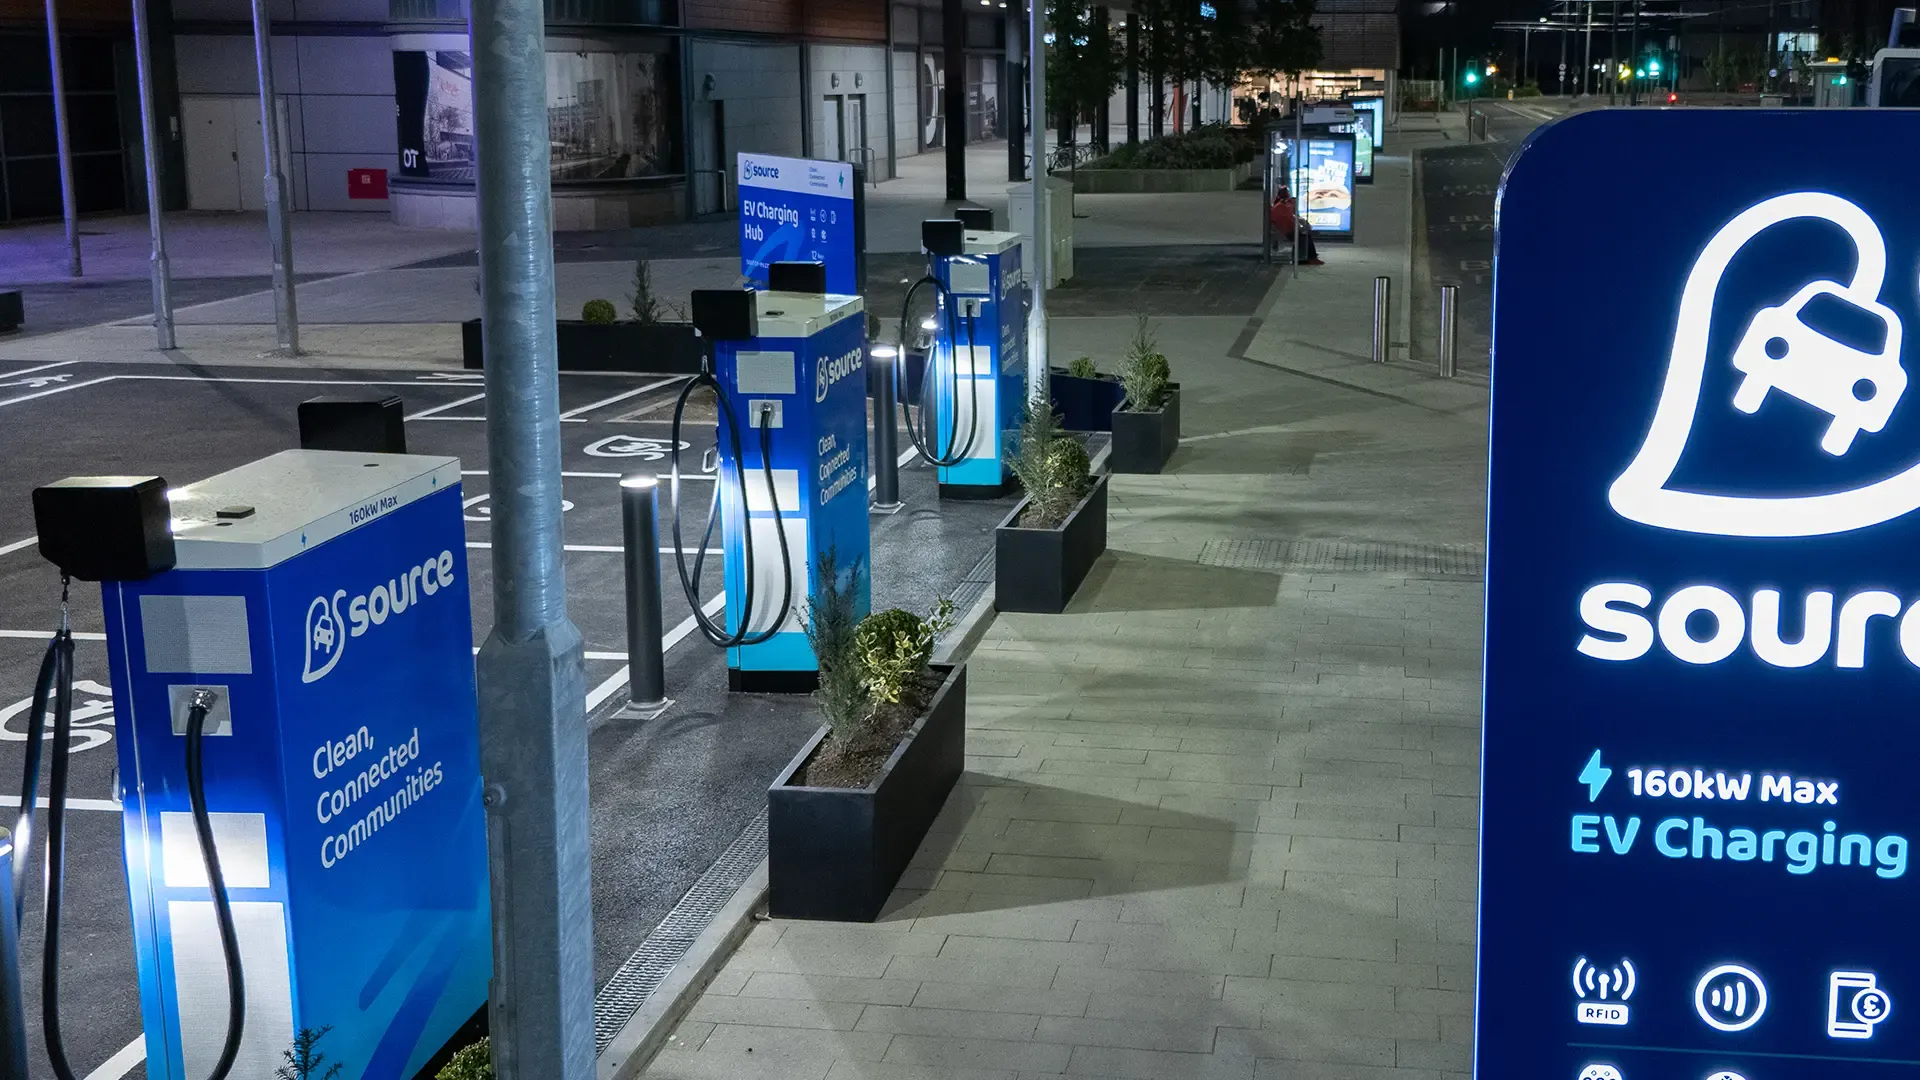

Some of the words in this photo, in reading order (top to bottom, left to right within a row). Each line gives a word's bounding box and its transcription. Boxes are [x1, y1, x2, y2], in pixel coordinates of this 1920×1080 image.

[753, 165, 780, 179] source
[744, 200, 756, 216] EV
[757, 201, 799, 228] Charging
[745, 223, 764, 242] Hub
[828, 347, 863, 386] source
[818, 433, 837, 457] Clean,
[819, 442, 850, 481] Connected
[349, 501, 378, 525] 160kW
[380, 495, 398, 512] Max
[349, 550, 454, 638] source
[313, 725, 374, 780] Clean,
[316, 727, 420, 824] Connected
[1627, 768, 1752, 801] 160kW
[1760, 774, 1839, 805] Max
[320, 760, 444, 869] Communities
[1571, 814, 1641, 855] EV
[1654, 816, 1908, 879] Charging
[1585, 1007, 1621, 1020] RFID
